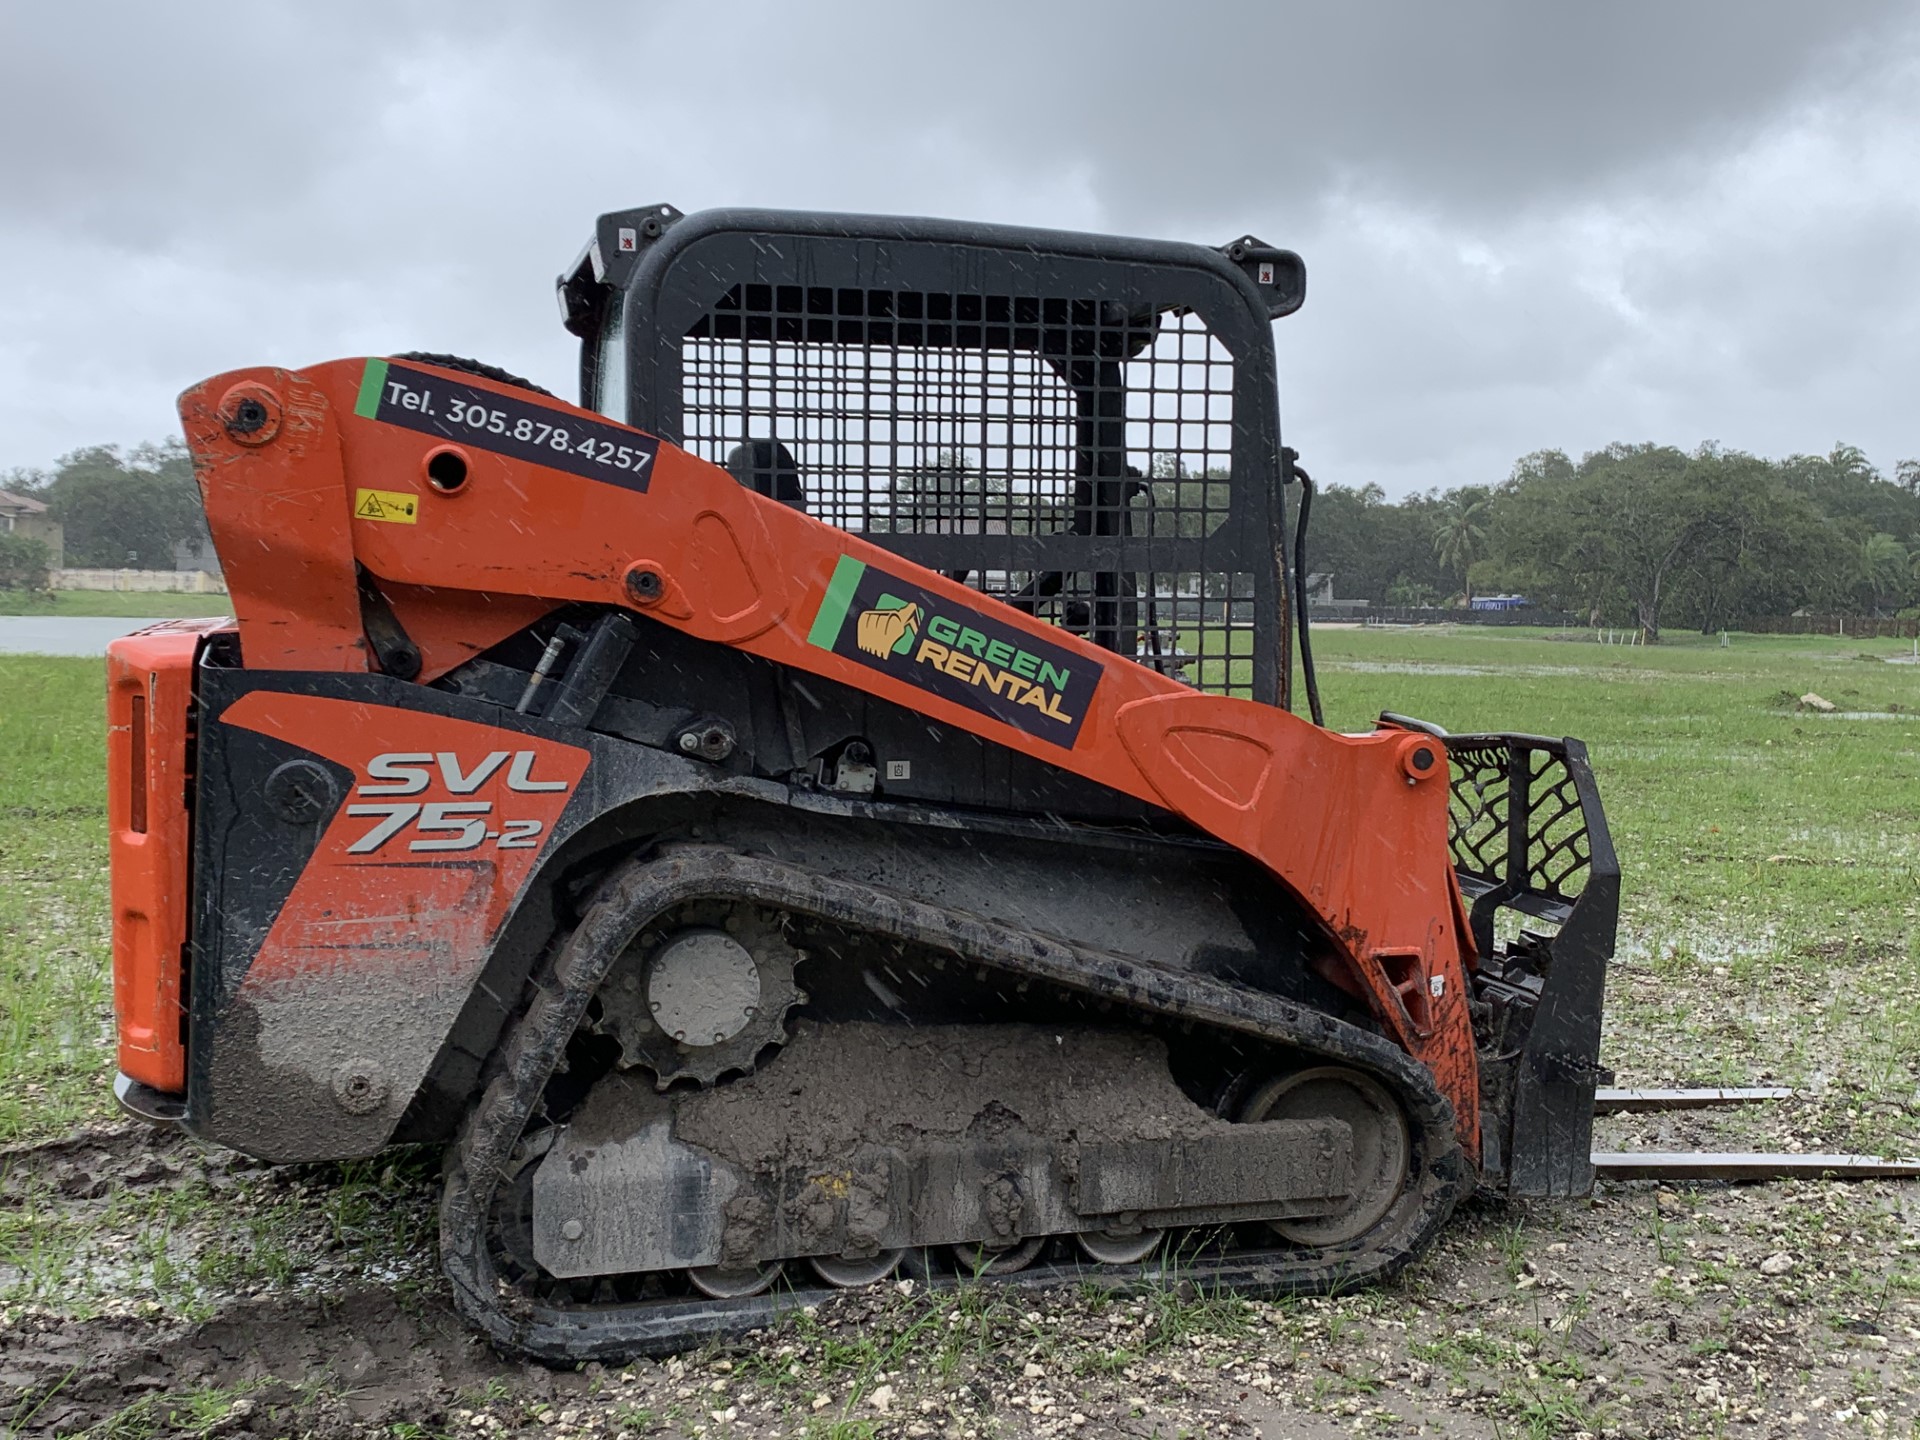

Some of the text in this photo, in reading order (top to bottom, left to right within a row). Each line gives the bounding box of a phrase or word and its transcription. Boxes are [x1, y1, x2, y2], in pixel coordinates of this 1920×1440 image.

[386, 380, 652, 474] Tel. 305.878.4257
[915, 639, 1073, 725] RENTAL
[927, 615, 1070, 692] GREEN
[356, 750, 569, 796] SVL
[345, 801, 543, 856] 75-2
